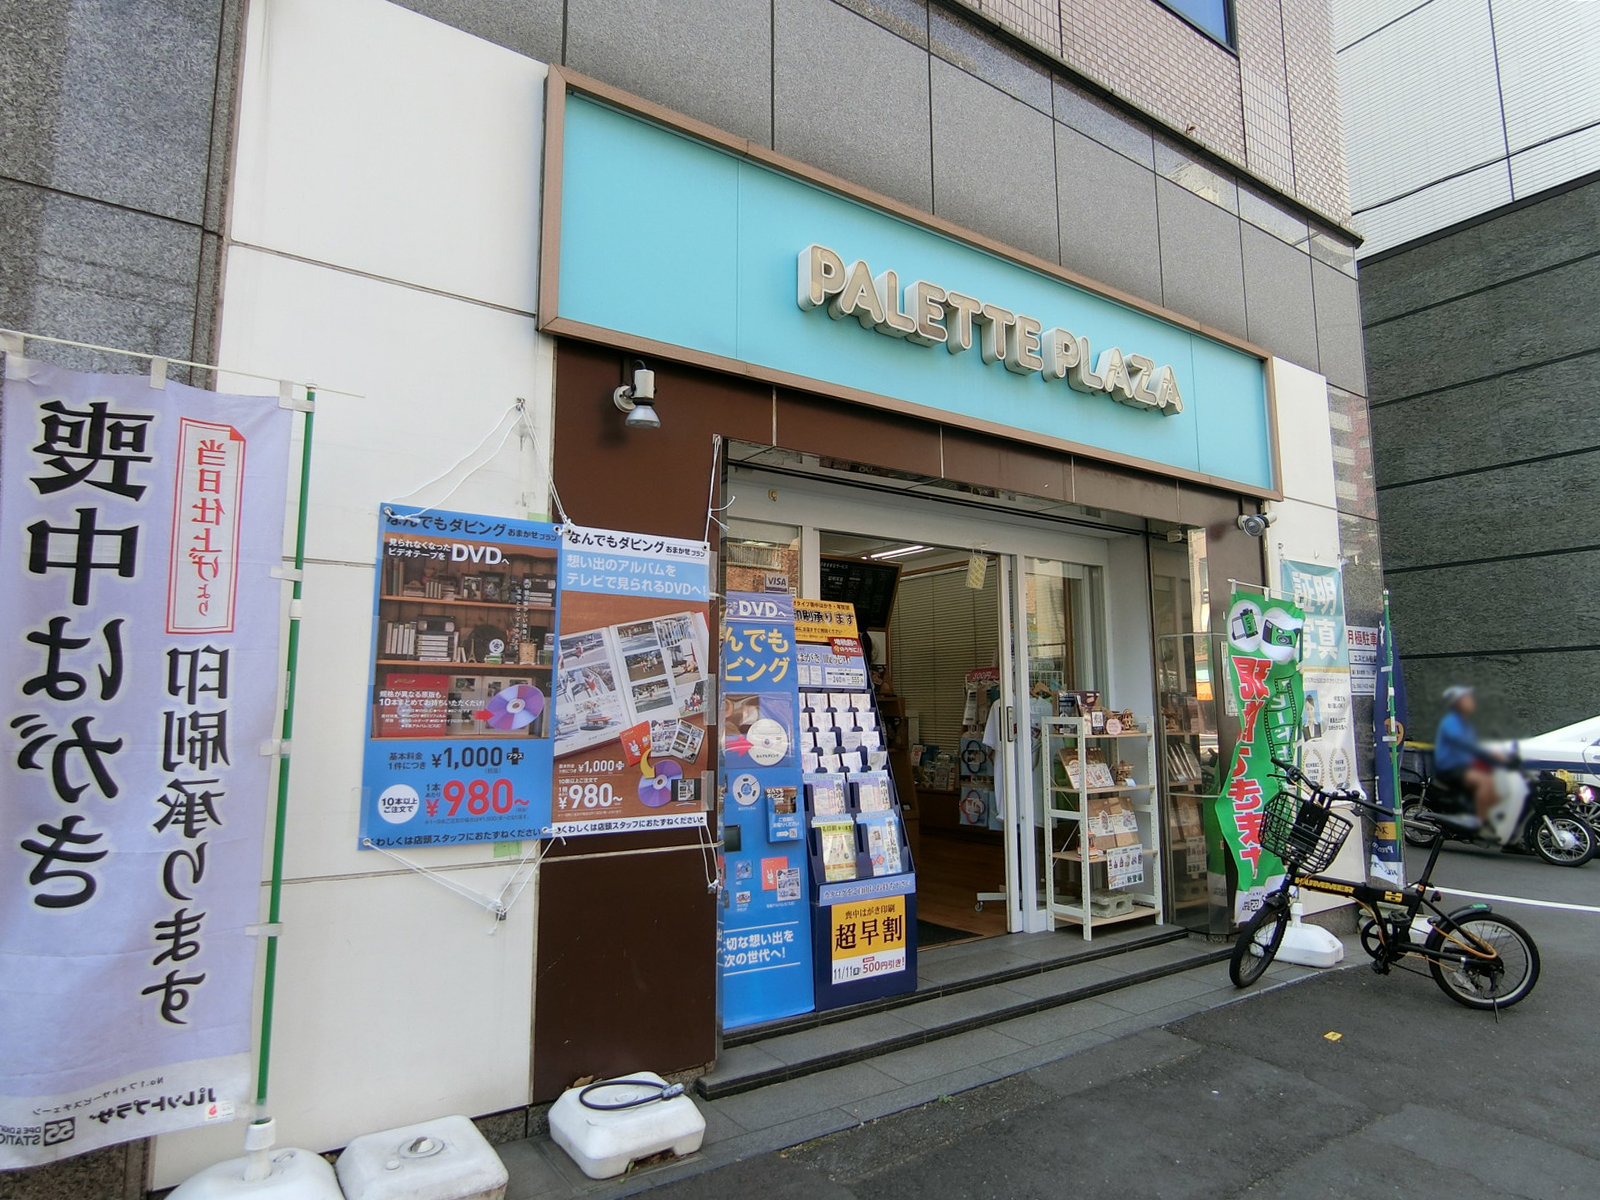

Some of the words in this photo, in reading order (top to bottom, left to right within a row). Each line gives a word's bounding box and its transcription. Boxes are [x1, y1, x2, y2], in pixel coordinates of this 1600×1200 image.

[797, 243, 1044, 376] PALETTE
[1041, 326, 1184, 417] PLAZA
[388, 538, 451, 552] 見られなくなった
[568, 531, 665, 553] なんでもダビング
[388, 548, 446, 561] ビデオテープを
[566, 554, 677, 577] 想い出のアルバムを
[768, 577, 787, 587] VISA
[1292, 571, 1337, 615] 証明
[388, 761, 426, 770] 1件につき
[389, 752, 423, 761] 基本料金
[431, 746, 503, 770] ¥1,000
[381, 797, 418, 806] 10本以上
[383, 806, 414, 814] ご注文で
[561, 816, 701, 834] くわしくは店頭スタッフにおたずねください
[1294, 877, 1355, 895] HUMMER
[845, 904, 895, 919] 喪中はがき印刷
[724, 930, 794, 951] 切な想い出を
[835, 914, 902, 952] 超早割
[724, 946, 786, 967] 次の世代へ!
